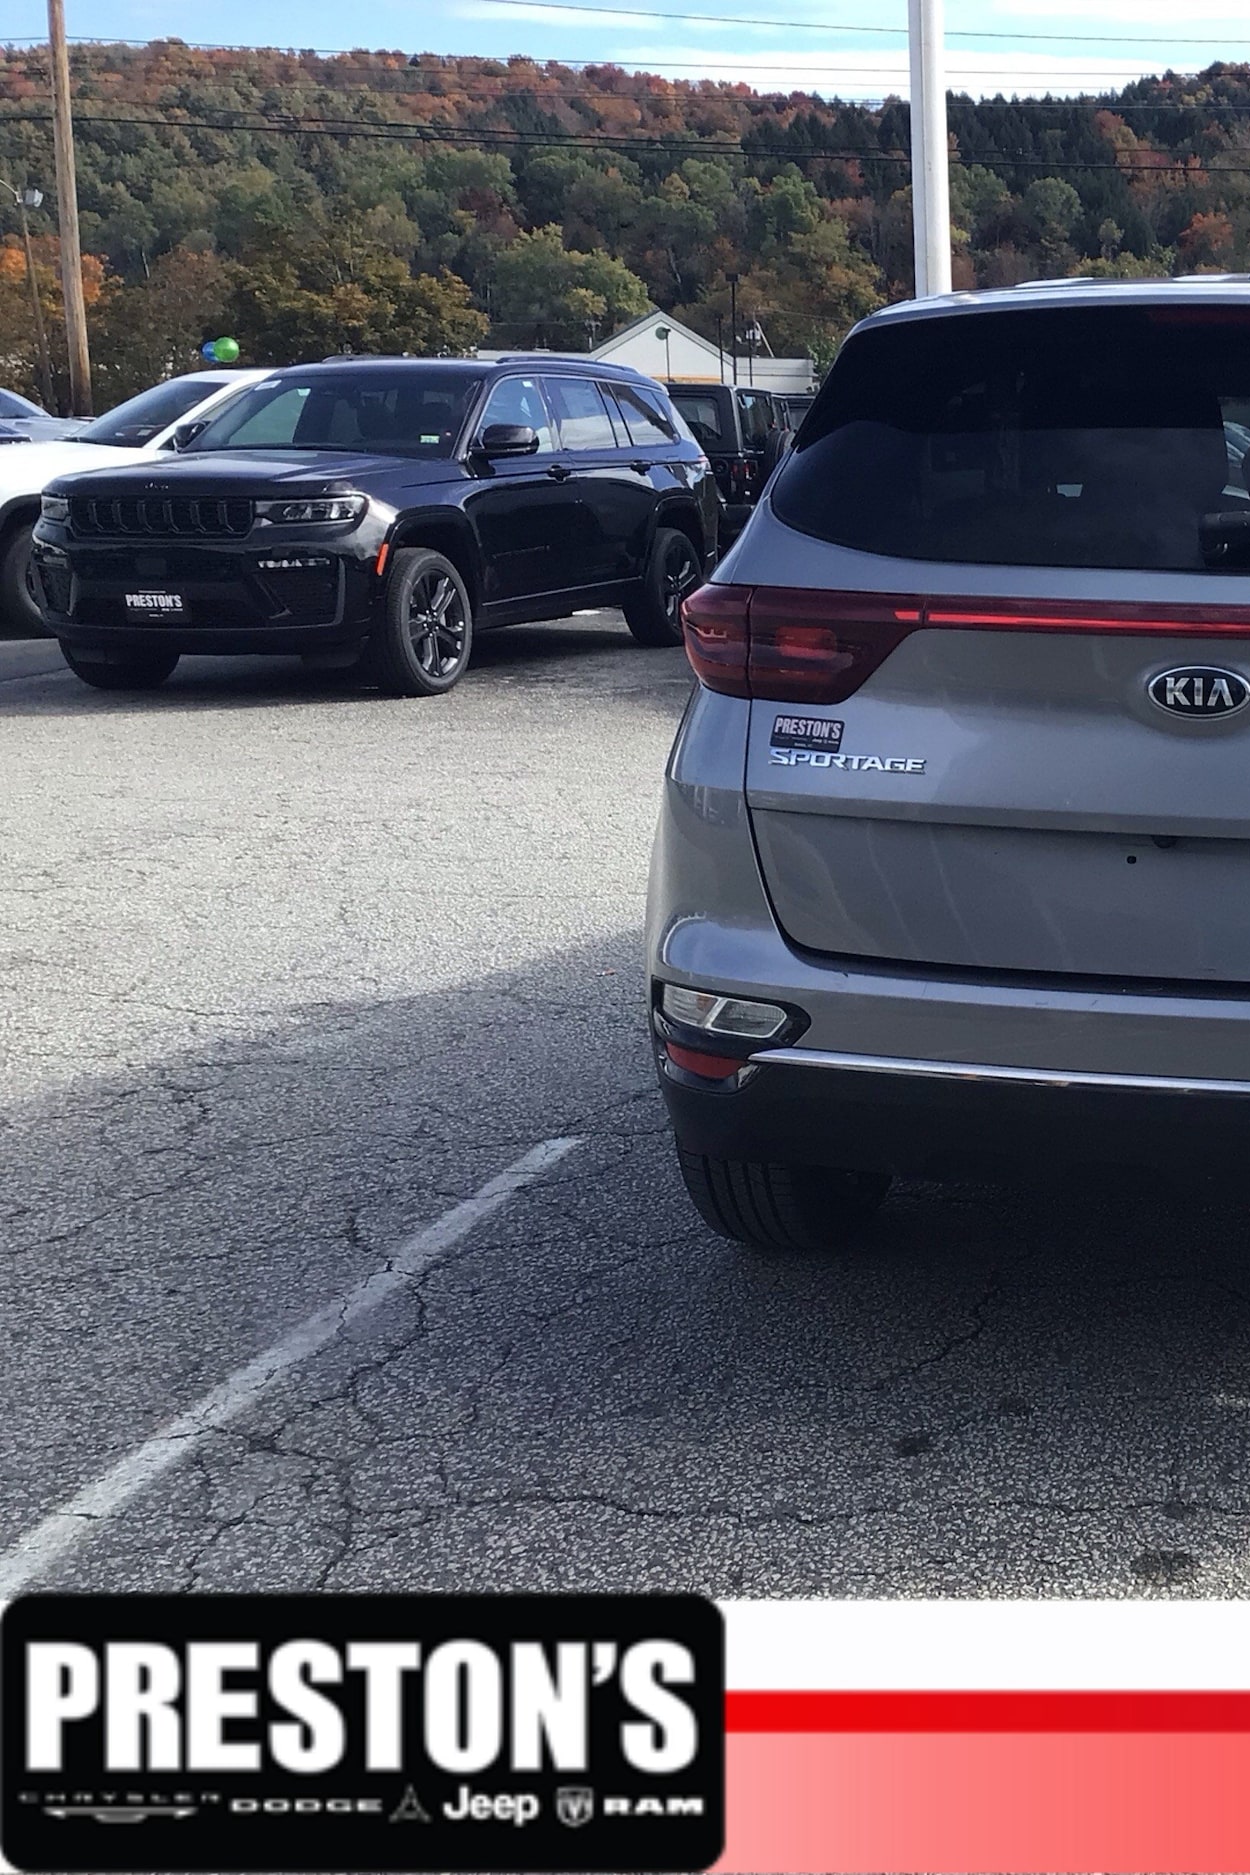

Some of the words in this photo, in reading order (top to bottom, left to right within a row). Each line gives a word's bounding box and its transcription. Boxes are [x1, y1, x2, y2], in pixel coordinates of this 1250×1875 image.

[125, 594, 183, 608] PRESTON'S
[1165, 676, 1234, 706] KIA
[774, 716, 842, 739] PRESTON'S
[768, 748, 925, 774] SPORTAGE
